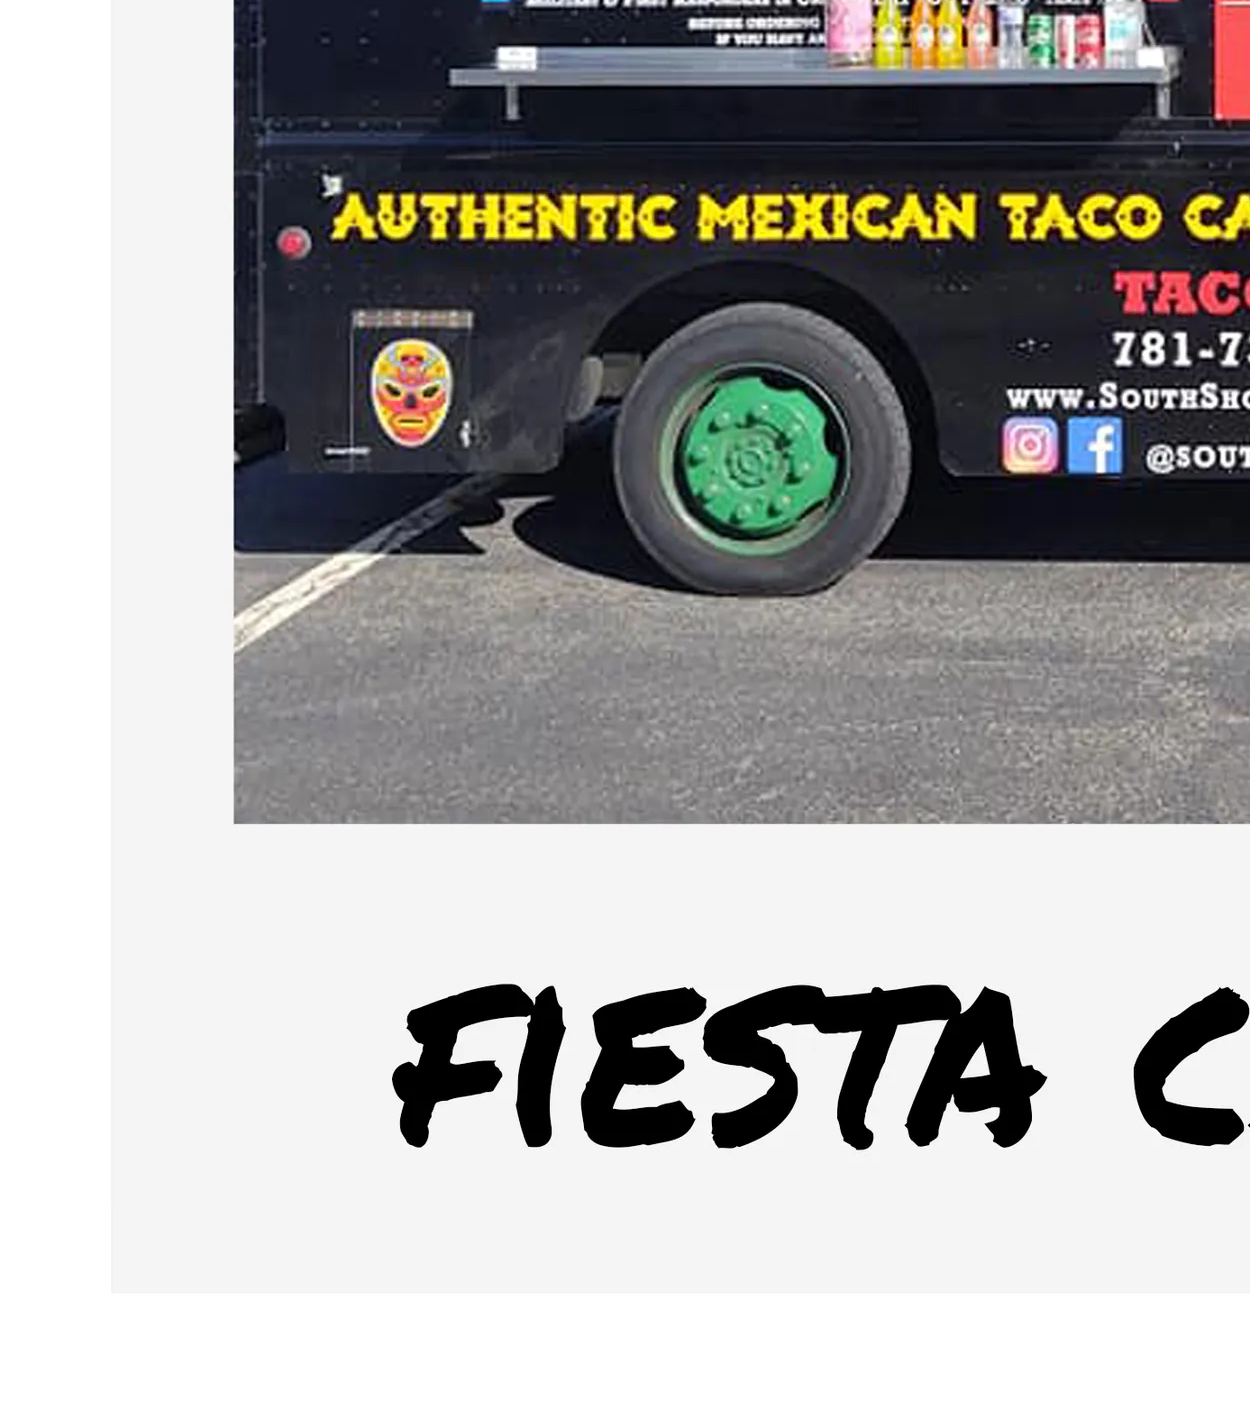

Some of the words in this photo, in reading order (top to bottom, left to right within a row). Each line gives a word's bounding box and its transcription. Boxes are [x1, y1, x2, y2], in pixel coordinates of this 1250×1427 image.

[331, 193, 676, 241] AUTHENTIC
[699, 193, 977, 241] MEXICAN
[999, 193, 1163, 241] TACO
